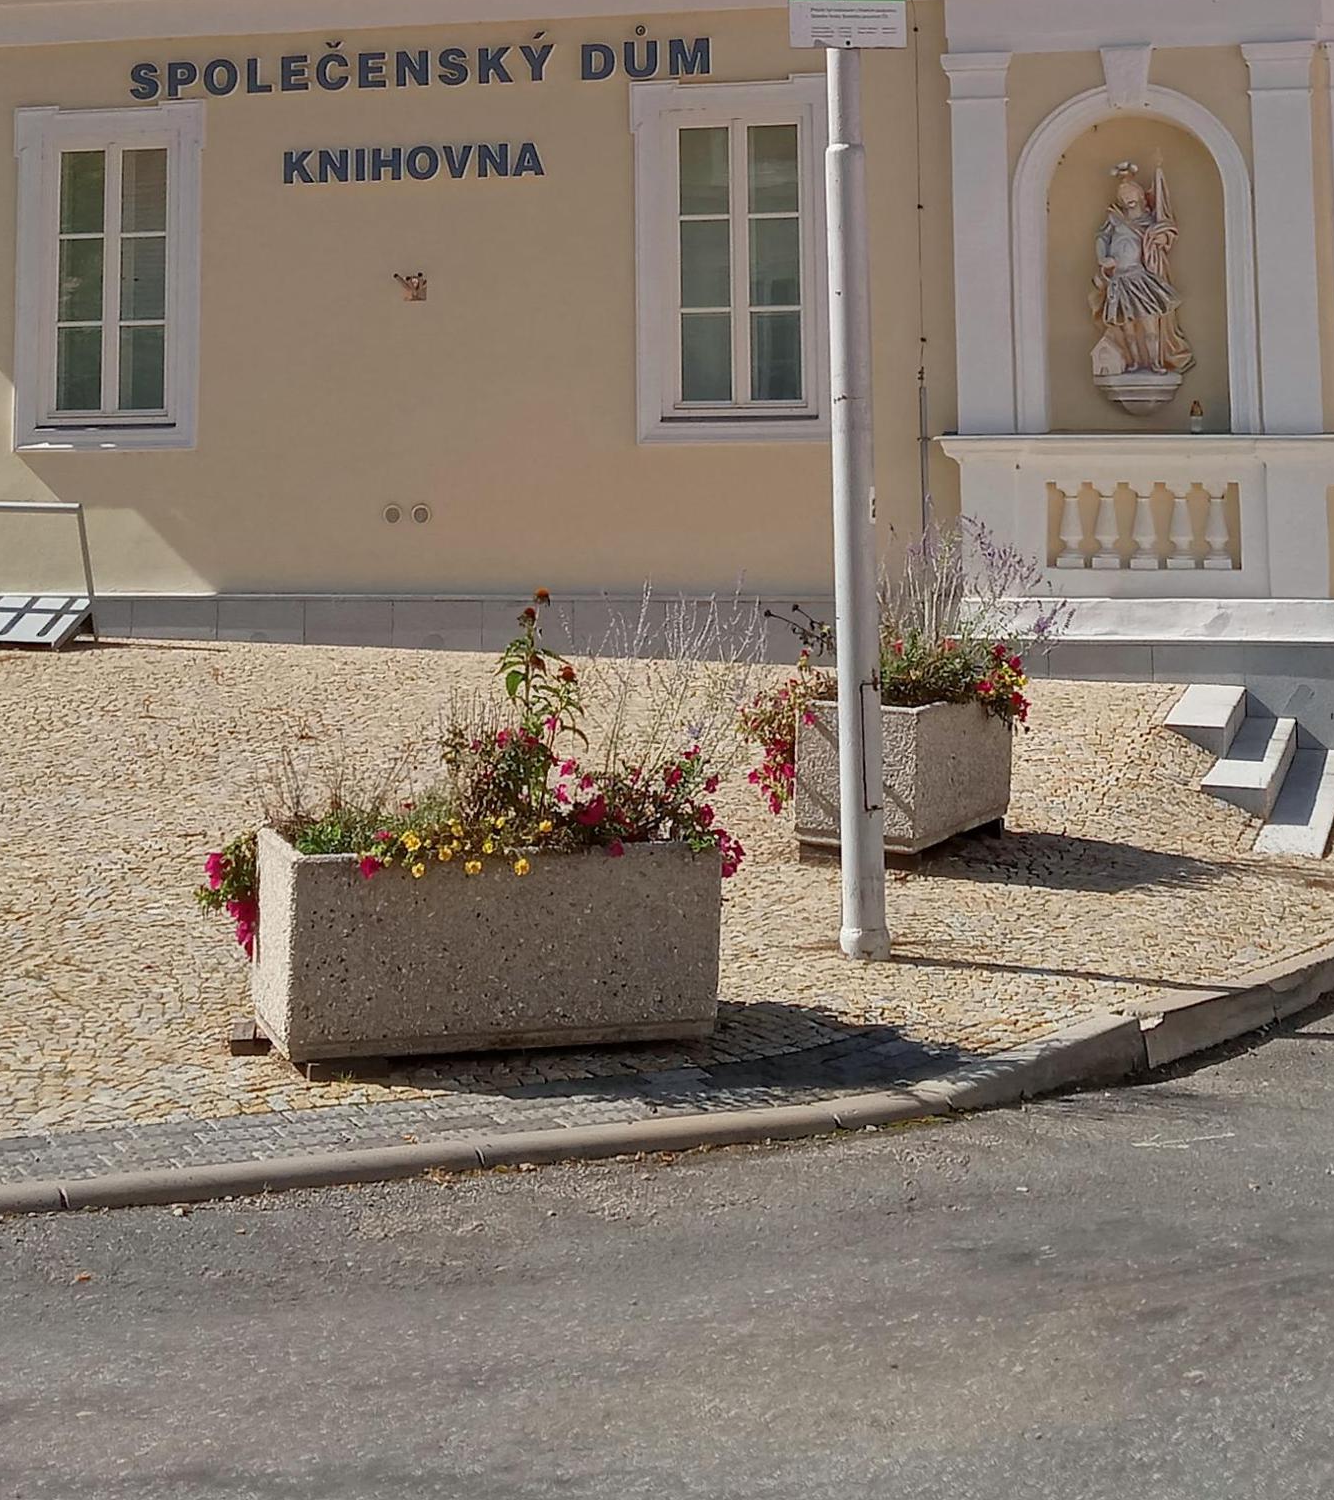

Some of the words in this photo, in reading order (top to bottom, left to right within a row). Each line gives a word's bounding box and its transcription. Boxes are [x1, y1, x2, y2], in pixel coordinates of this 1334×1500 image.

[129, 30, 556, 100] SPOLEČENSKÝ
[580, 24, 711, 81] DŮM
[282, 141, 546, 185] KNIHOVNA
